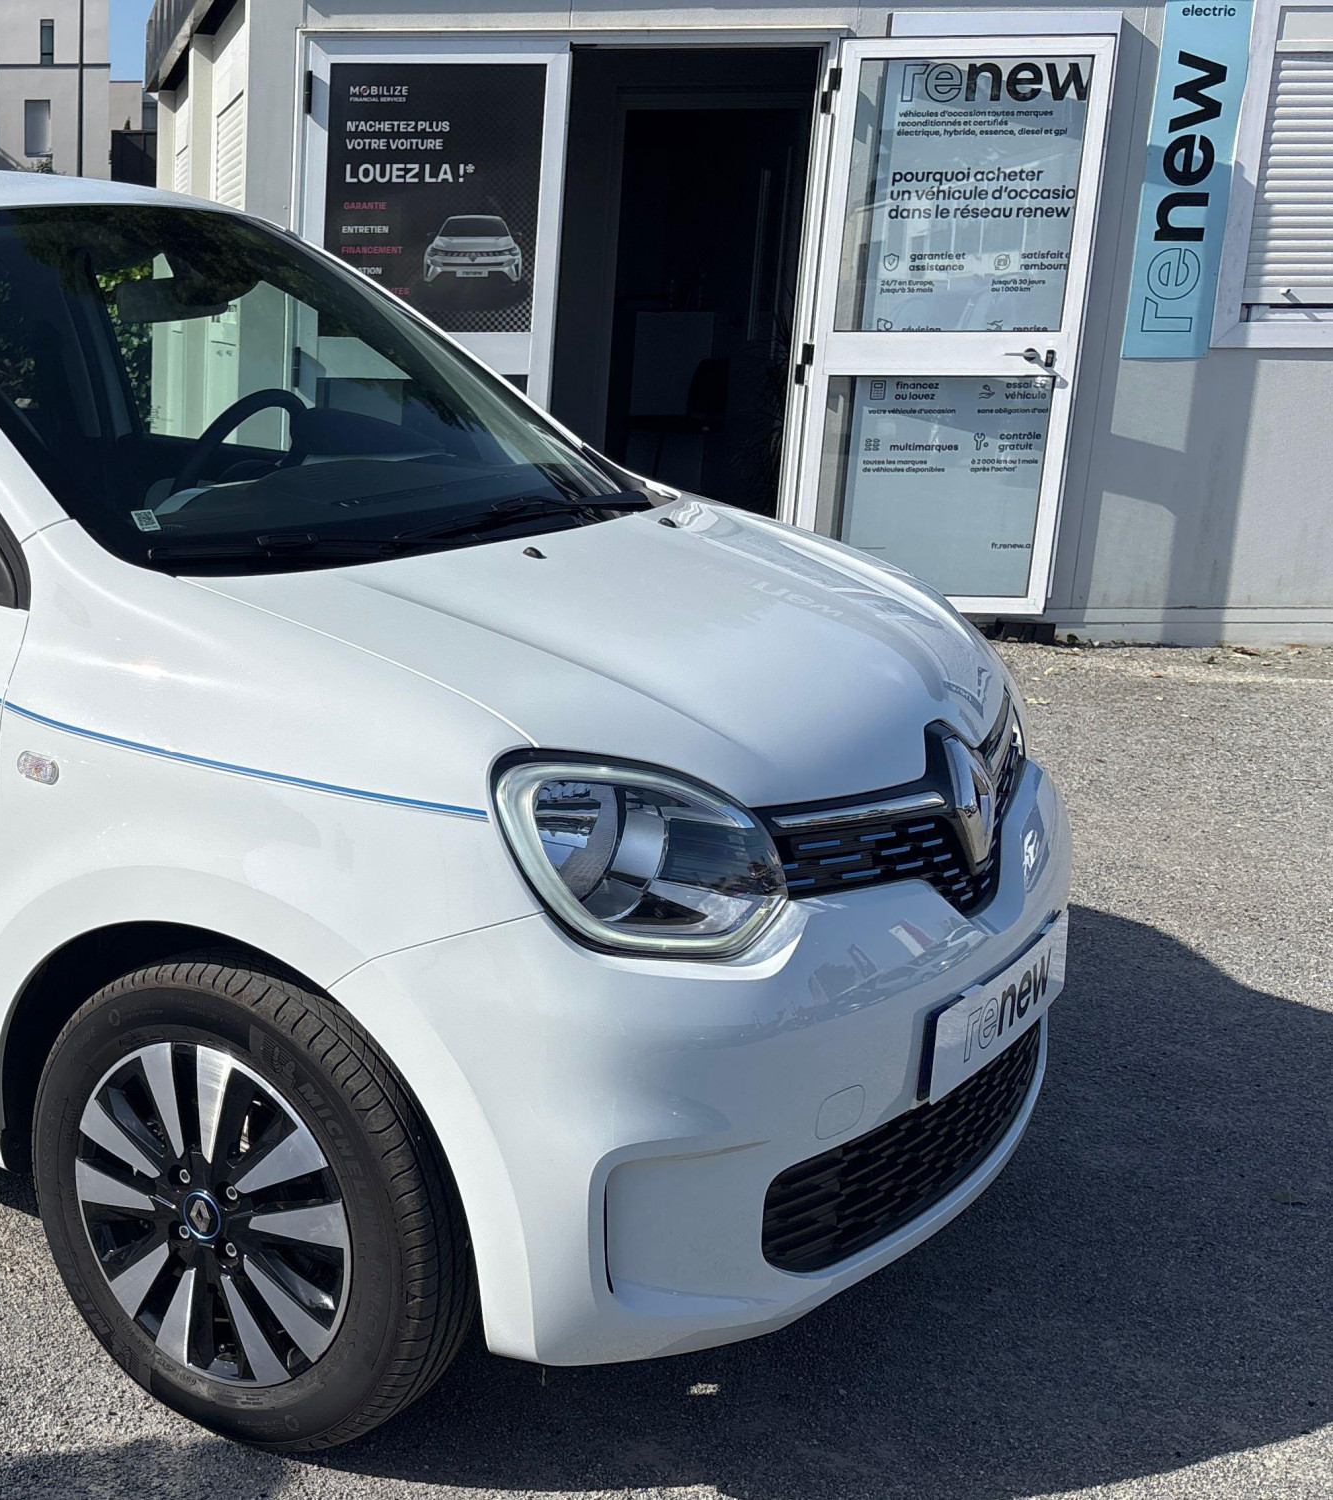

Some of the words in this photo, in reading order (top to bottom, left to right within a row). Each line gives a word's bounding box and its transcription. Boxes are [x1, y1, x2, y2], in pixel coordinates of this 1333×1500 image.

[1181, 4, 1237, 18] electric
[900, 62, 1090, 103] renew
[349, 85, 409, 96] MOBILIZE
[898, 109, 938, 118] véhicules
[940, 109, 986, 118] d'occasion
[1016, 109, 1054, 119] marques
[347, 120, 415, 132] N'ACHETEZ
[417, 120, 450, 132] PLUS
[897, 118, 961, 127] reconditionnés
[973, 118, 1009, 127] certifiés
[896, 128, 942, 138] électrique,
[943, 128, 978, 138] hybride,
[979, 129, 1016, 138] essence,
[1017, 127, 1043, 136] diesel
[1054, 127, 1068, 138] gpl
[346, 139, 387, 150] VOTRE
[389, 139, 444, 150] VOITURE
[345, 163, 420, 183] LOUEZ
[424, 163, 454, 183] LA
[891, 167, 971, 186] pourquoi
[974, 167, 1044, 182] acheter
[890, 189, 912, 201] un
[915, 186, 988, 201] véhicule
[1140, 50, 1228, 333] renew
[343, 201, 387, 210] GARANTIE
[888, 205, 932, 219] dans
[935, 205, 950, 219] le
[954, 205, 1013, 219] réseau
[1016, 206, 1070, 218] renew
[342, 225, 389, 234] ENTRETIEN
[341, 246, 403, 254] FINANCEMENT
[1021, 250, 1064, 259] satisfait
[909, 253, 954, 263] garantie
[955, 253, 967, 261] et
[908, 262, 965, 272] assistance
[880, 279, 898, 287] 24/7
[1027, 278, 1046, 286] jours
[896, 381, 940, 390] financez
[1006, 381, 1032, 389] essai
[908, 392, 936, 400] louez
[1004, 391, 1047, 400] véhicule
[994, 407, 1031, 415] obligation
[999, 431, 1042, 440] contrôle
[889, 442, 959, 453] multimarques
[998, 442, 1033, 453] gratuit
[905, 466, 945, 474] disponibles
[970, 466, 990, 474] après
[963, 946, 1052, 1064] renew
